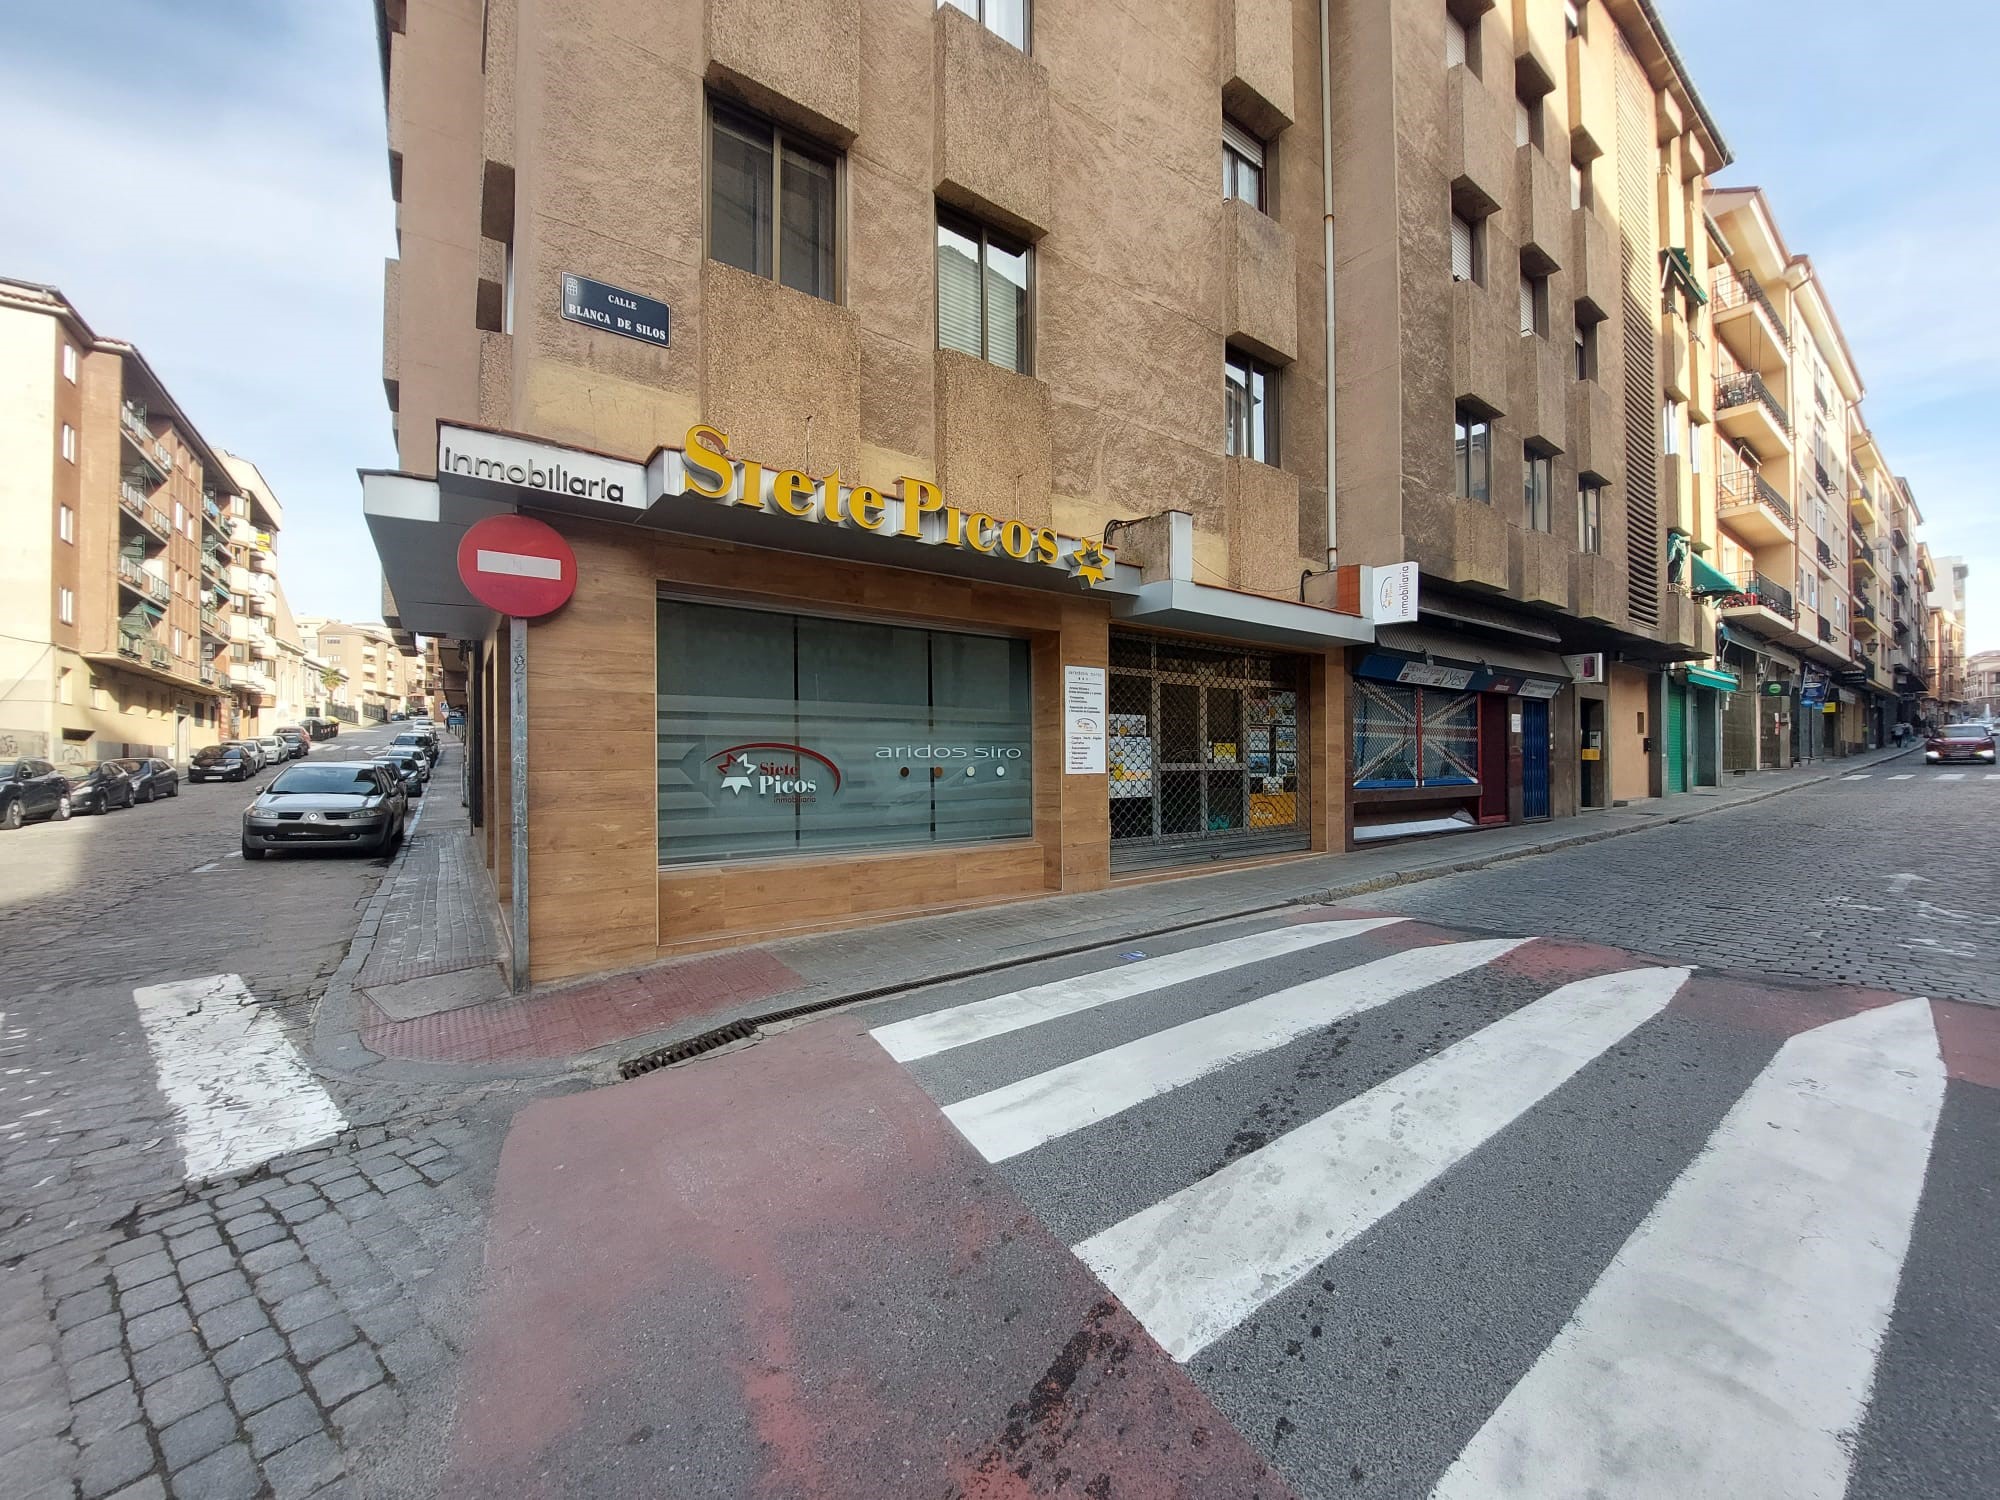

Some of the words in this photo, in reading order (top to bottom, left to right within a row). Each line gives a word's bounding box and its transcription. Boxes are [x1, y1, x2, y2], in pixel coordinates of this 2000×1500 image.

[607, 294, 638, 311] CALLE
[568, 303, 612, 325] BLANCA
[617, 317, 632, 331] DE
[636, 323, 666, 340] SILOS
[444, 446, 624, 503] inmobiliaria
[684, 423, 886, 530] Siete
[895, 475, 1060, 565] Picos
[1398, 565, 1409, 617] inmobiliaria
[875, 744, 967, 759] aridos
[974, 745, 1022, 759] siro
[759, 761, 799, 777] Siete
[758, 774, 817, 794] Picos
